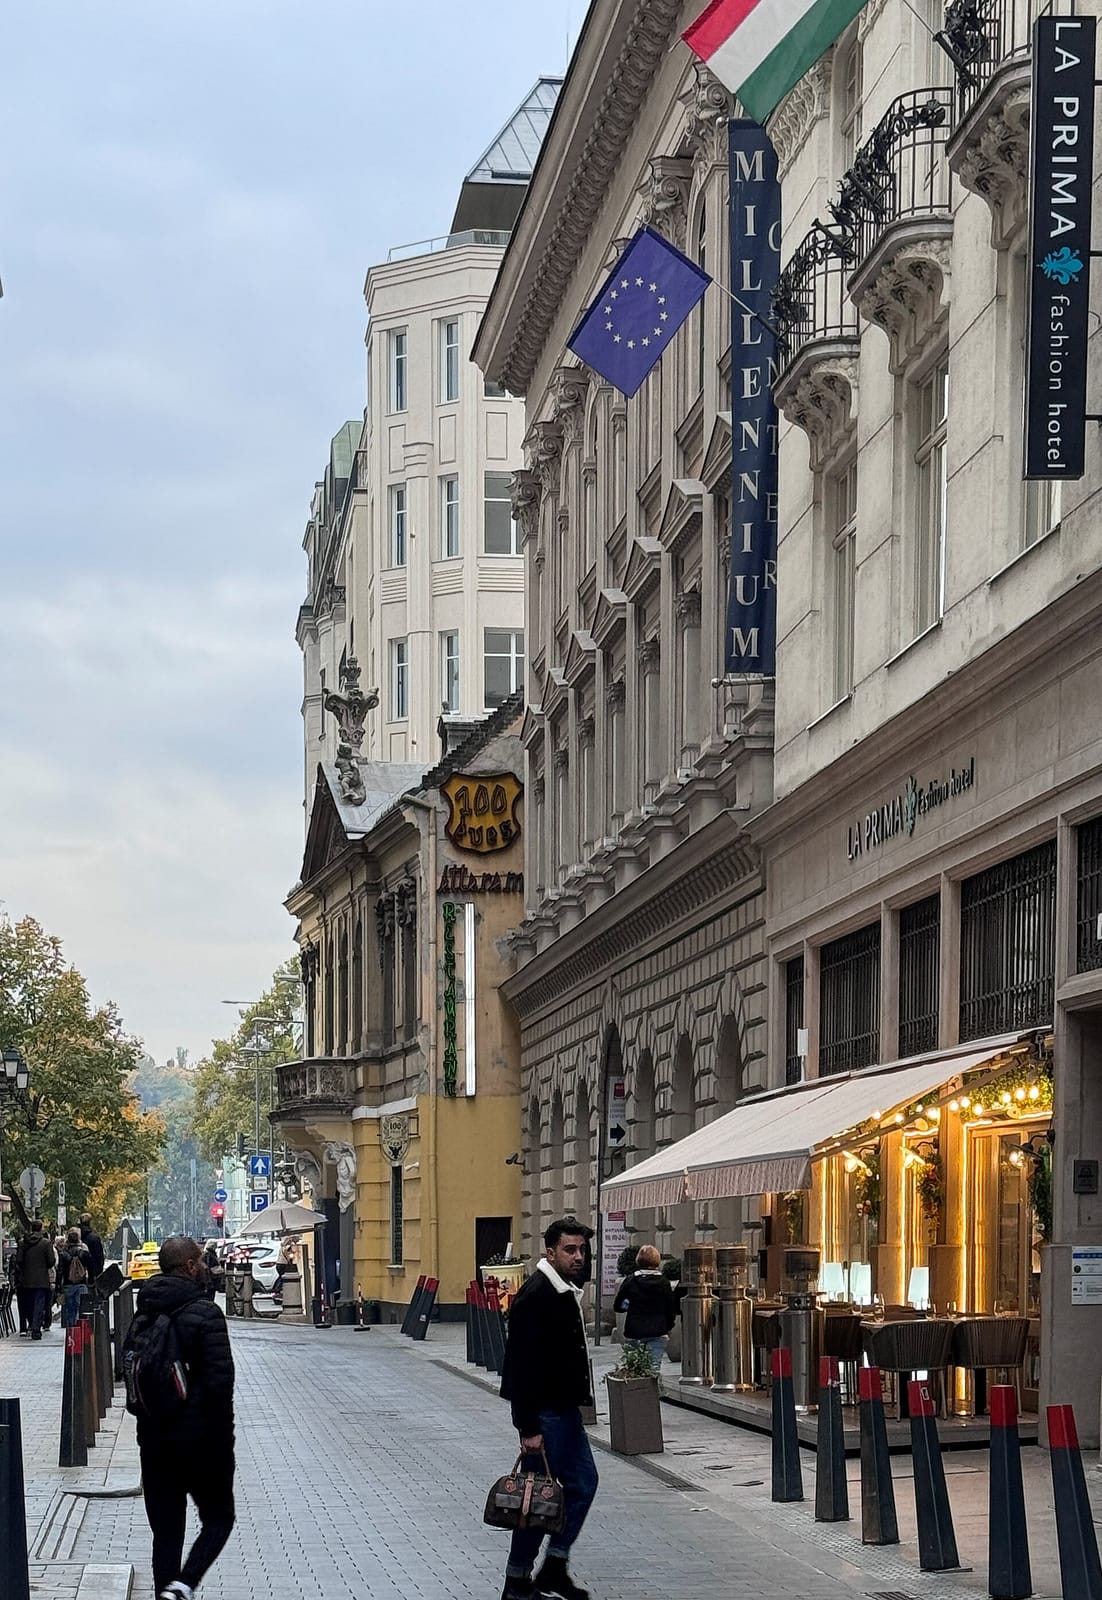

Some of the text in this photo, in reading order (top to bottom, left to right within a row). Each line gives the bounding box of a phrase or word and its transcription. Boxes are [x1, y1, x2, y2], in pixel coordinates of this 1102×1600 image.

[1047, 22, 1082, 468] LA PRIMA fashion hotel
[730, 150, 766, 658] MILLENNIUM
[455, 784, 508, 816] 100
[847, 757, 975, 861] LA PRIMA fashion hotel
[254, 1196, 265, 1211] P
